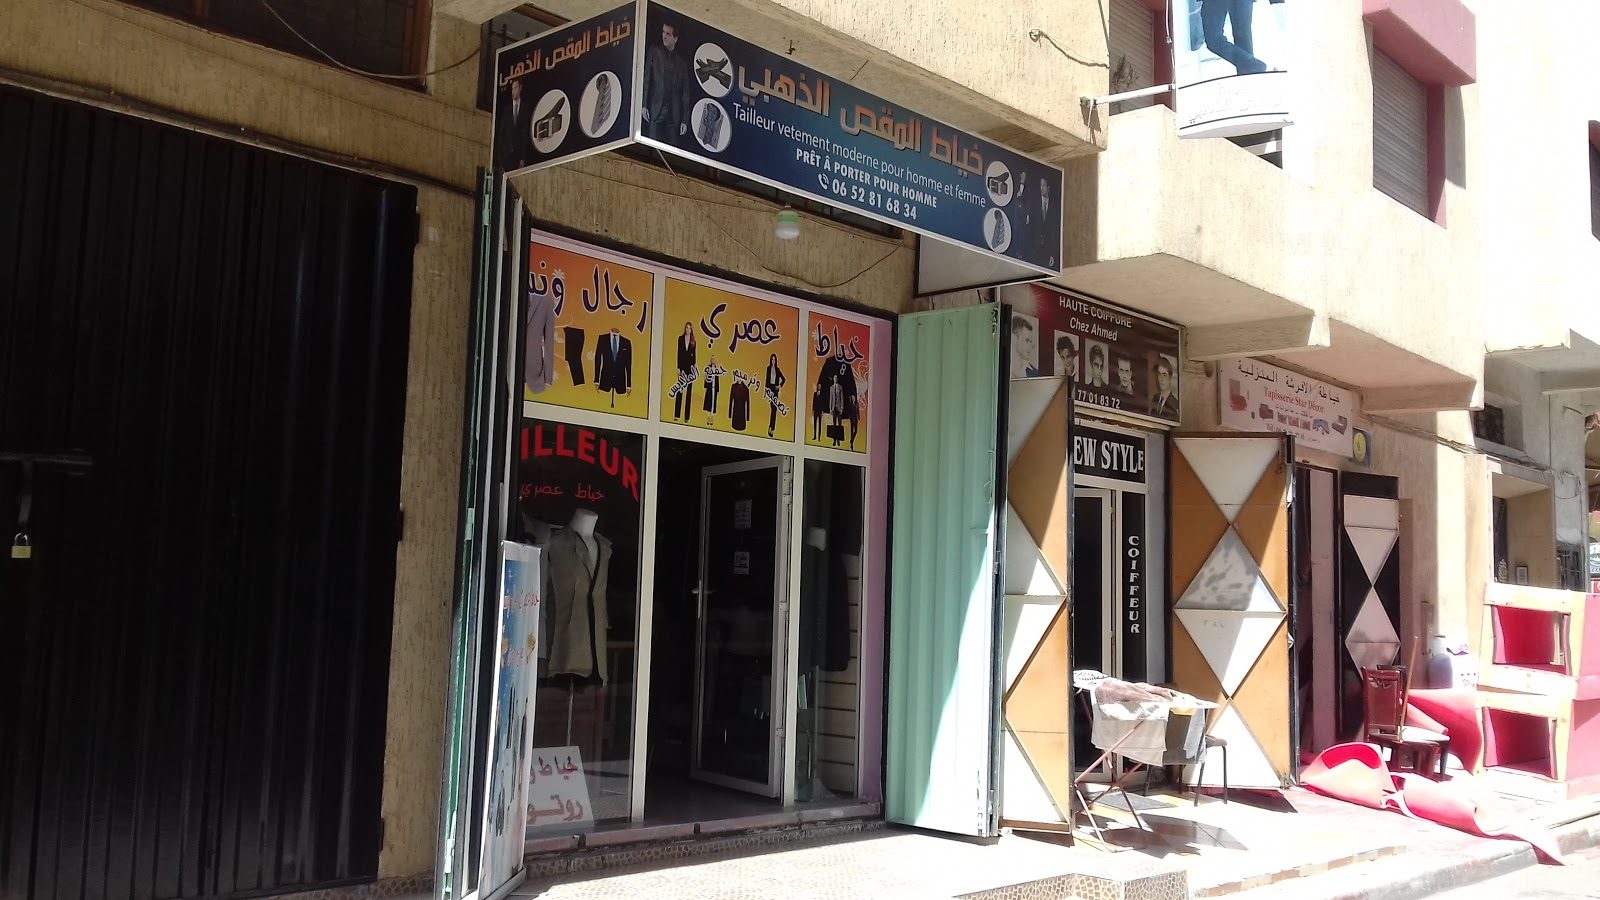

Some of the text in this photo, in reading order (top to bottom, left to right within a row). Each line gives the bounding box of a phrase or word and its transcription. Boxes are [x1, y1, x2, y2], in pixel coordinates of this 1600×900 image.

[499, 17, 631, 91] خياط المقص الذهبي
[738, 65, 983, 178] خياط المقص الذهبي
[733, 102, 986, 208] Tailleur vetement moderne pour homme et femme
[796, 148, 821, 167] PRÊT
[834, 162, 871, 186] PORTER
[873, 175, 899, 195] POUR
[902, 186, 937, 208] HOMME
[832, 178, 917, 220] 06 52 81 68 34
[582, 264, 648, 333] رجال
[1059, 296, 1133, 329] HAUTE COIFFURE
[700, 303, 780, 353] عصري
[815, 321, 864, 376] خياط
[1069, 316, 1119, 341] Chez Ahmed
[1077, 389, 1121, 410] 77 01 83 72
[521, 424, 639, 502] ILLEUR
[1101, 439, 1144, 474] STYLE
[1128, 535, 1141, 634] COIFFEUR
